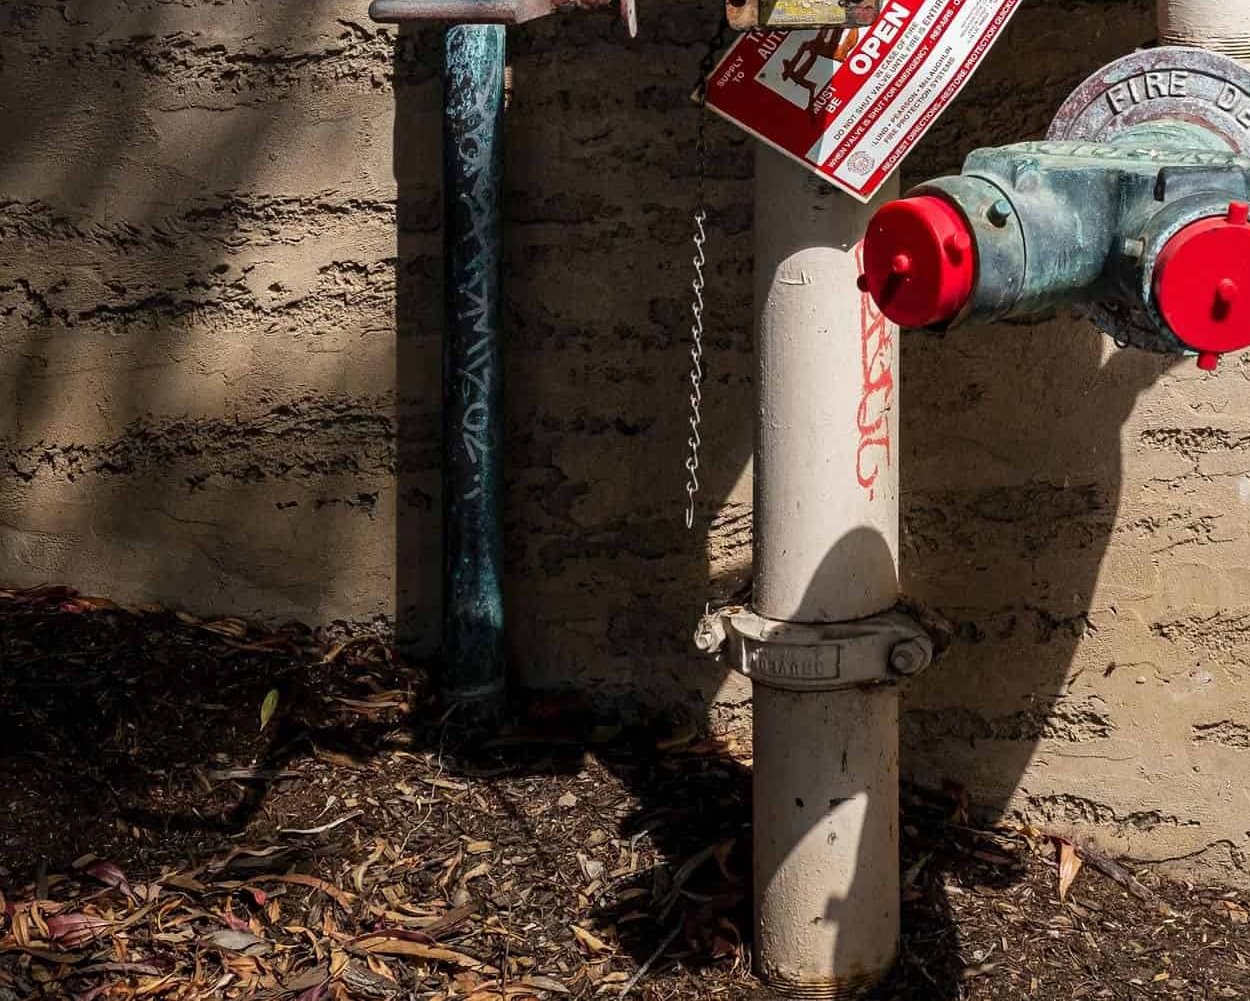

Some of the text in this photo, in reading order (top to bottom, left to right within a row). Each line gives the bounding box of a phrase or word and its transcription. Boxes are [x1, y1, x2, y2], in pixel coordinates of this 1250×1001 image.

[846, 0, 911, 78] OPEN
[874, 21, 918, 78] IN CASE OF FIRE
[716, 55, 744, 88] SUPPLY
[732, 70, 745, 83] TO
[810, 84, 836, 114] MUST
[833, 129, 844, 140] DO
[843, 114, 857, 129] NOT
[855, 95, 872, 113] SHUT
[871, 72, 891, 94] VALVE
[889, 51, 907, 72] UNTIL
[905, 34, 919, 52] FIRE
[917, 25, 926, 34] IS
[882, 139, 910, 171] REQUEST
[964, 24, 998, 69] PROTECTION
[1105, 70, 1188, 116] FIRE
[825, 96, 842, 114] BE
[828, 146, 847, 168] WHEN
[844, 125, 864, 148] VALVE
[862, 117, 870, 126] IS
[867, 100, 885, 119] SHUT
[883, 86, 897, 101] FOR
[894, 44, 929, 87] EMERGENCY
[871, 126, 889, 145] LUND
[889, 91, 917, 123] PEARSON
[883, 56, 955, 144] FIRE PROTECTION SYSTEMS
